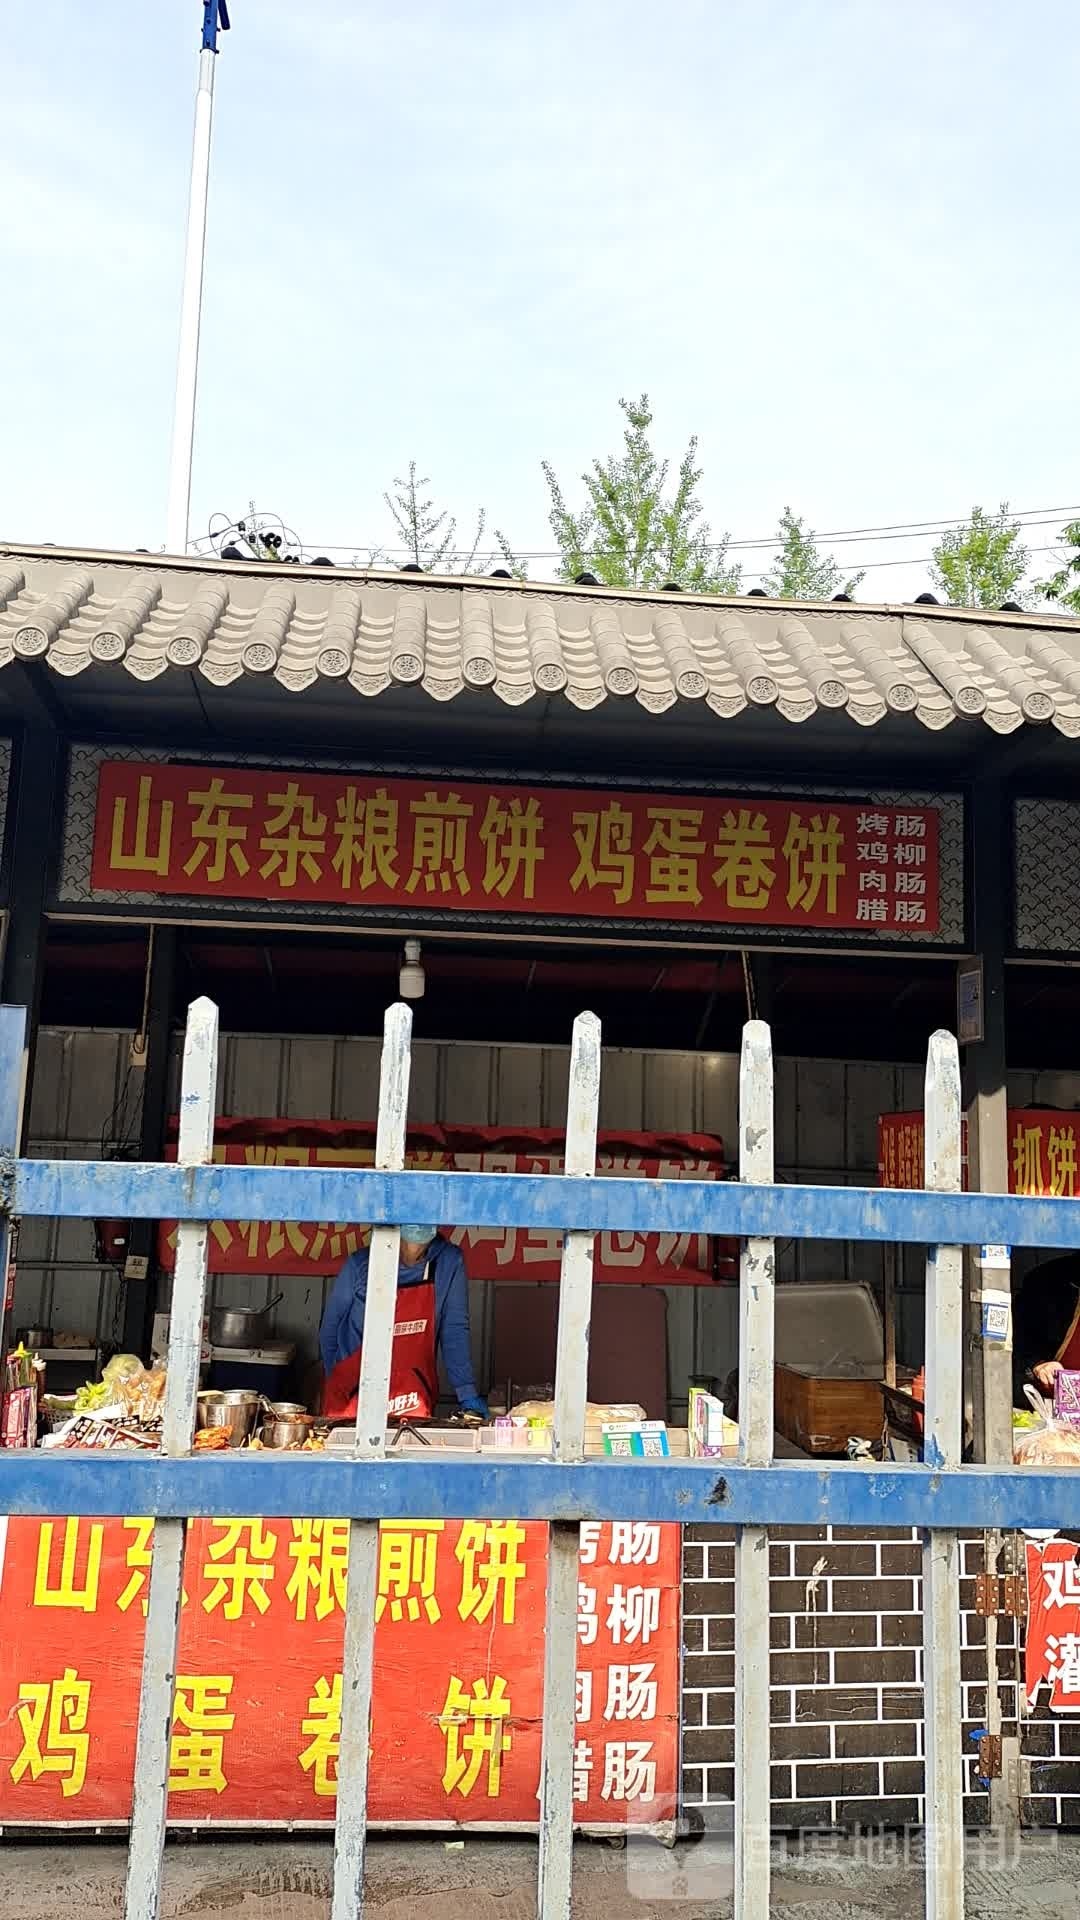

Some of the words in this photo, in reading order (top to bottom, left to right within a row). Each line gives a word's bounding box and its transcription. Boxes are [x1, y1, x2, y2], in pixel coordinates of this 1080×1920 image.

[856, 812, 926, 837] 烤肠
[109, 775, 546, 899] 山东杂粮煎饼
[569, 801, 847, 914] 鸡蛋卷饼
[856, 841, 926, 866] 鸡柳
[859, 870, 926, 894] 肉肠
[856, 898, 926, 923] 腊肠
[1013, 1123, 1078, 1197] 抓饼
[10, 1668, 512, 1798] 鸡蛋卷饼
